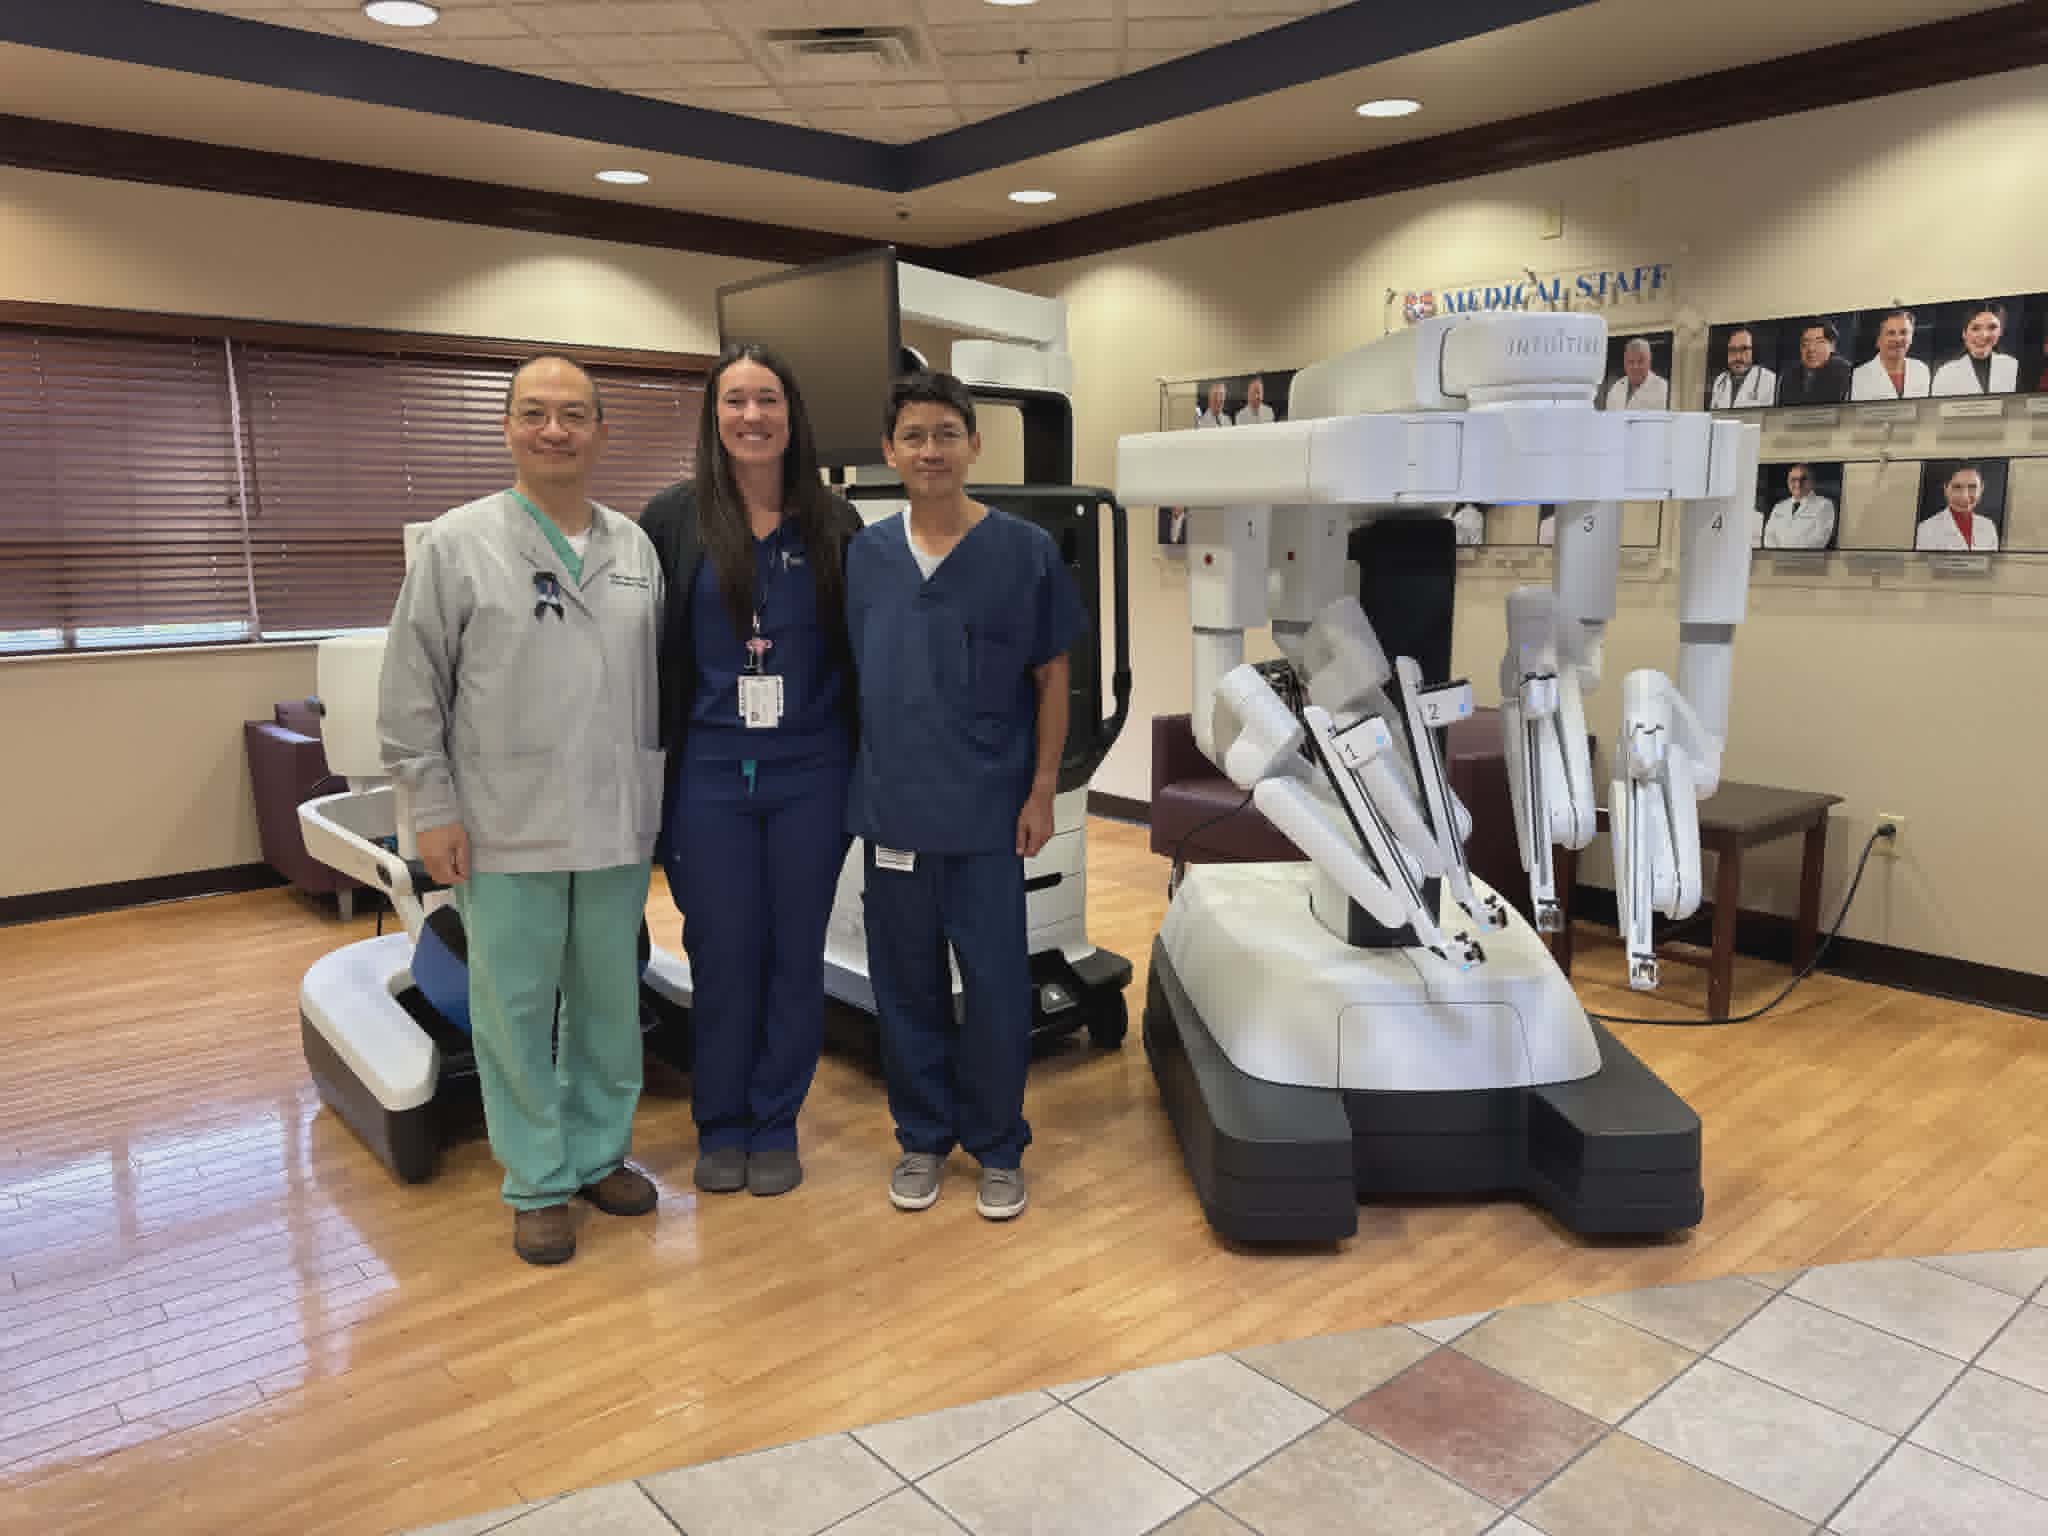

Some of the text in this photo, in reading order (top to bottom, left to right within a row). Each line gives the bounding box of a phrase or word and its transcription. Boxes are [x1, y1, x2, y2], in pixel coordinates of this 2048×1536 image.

[1443, 263, 1669, 313] MEDICAL STAFF
[1583, 512, 1595, 534] 3
[1711, 512, 1723, 534] 4
[1427, 702, 1441, 721] 2
